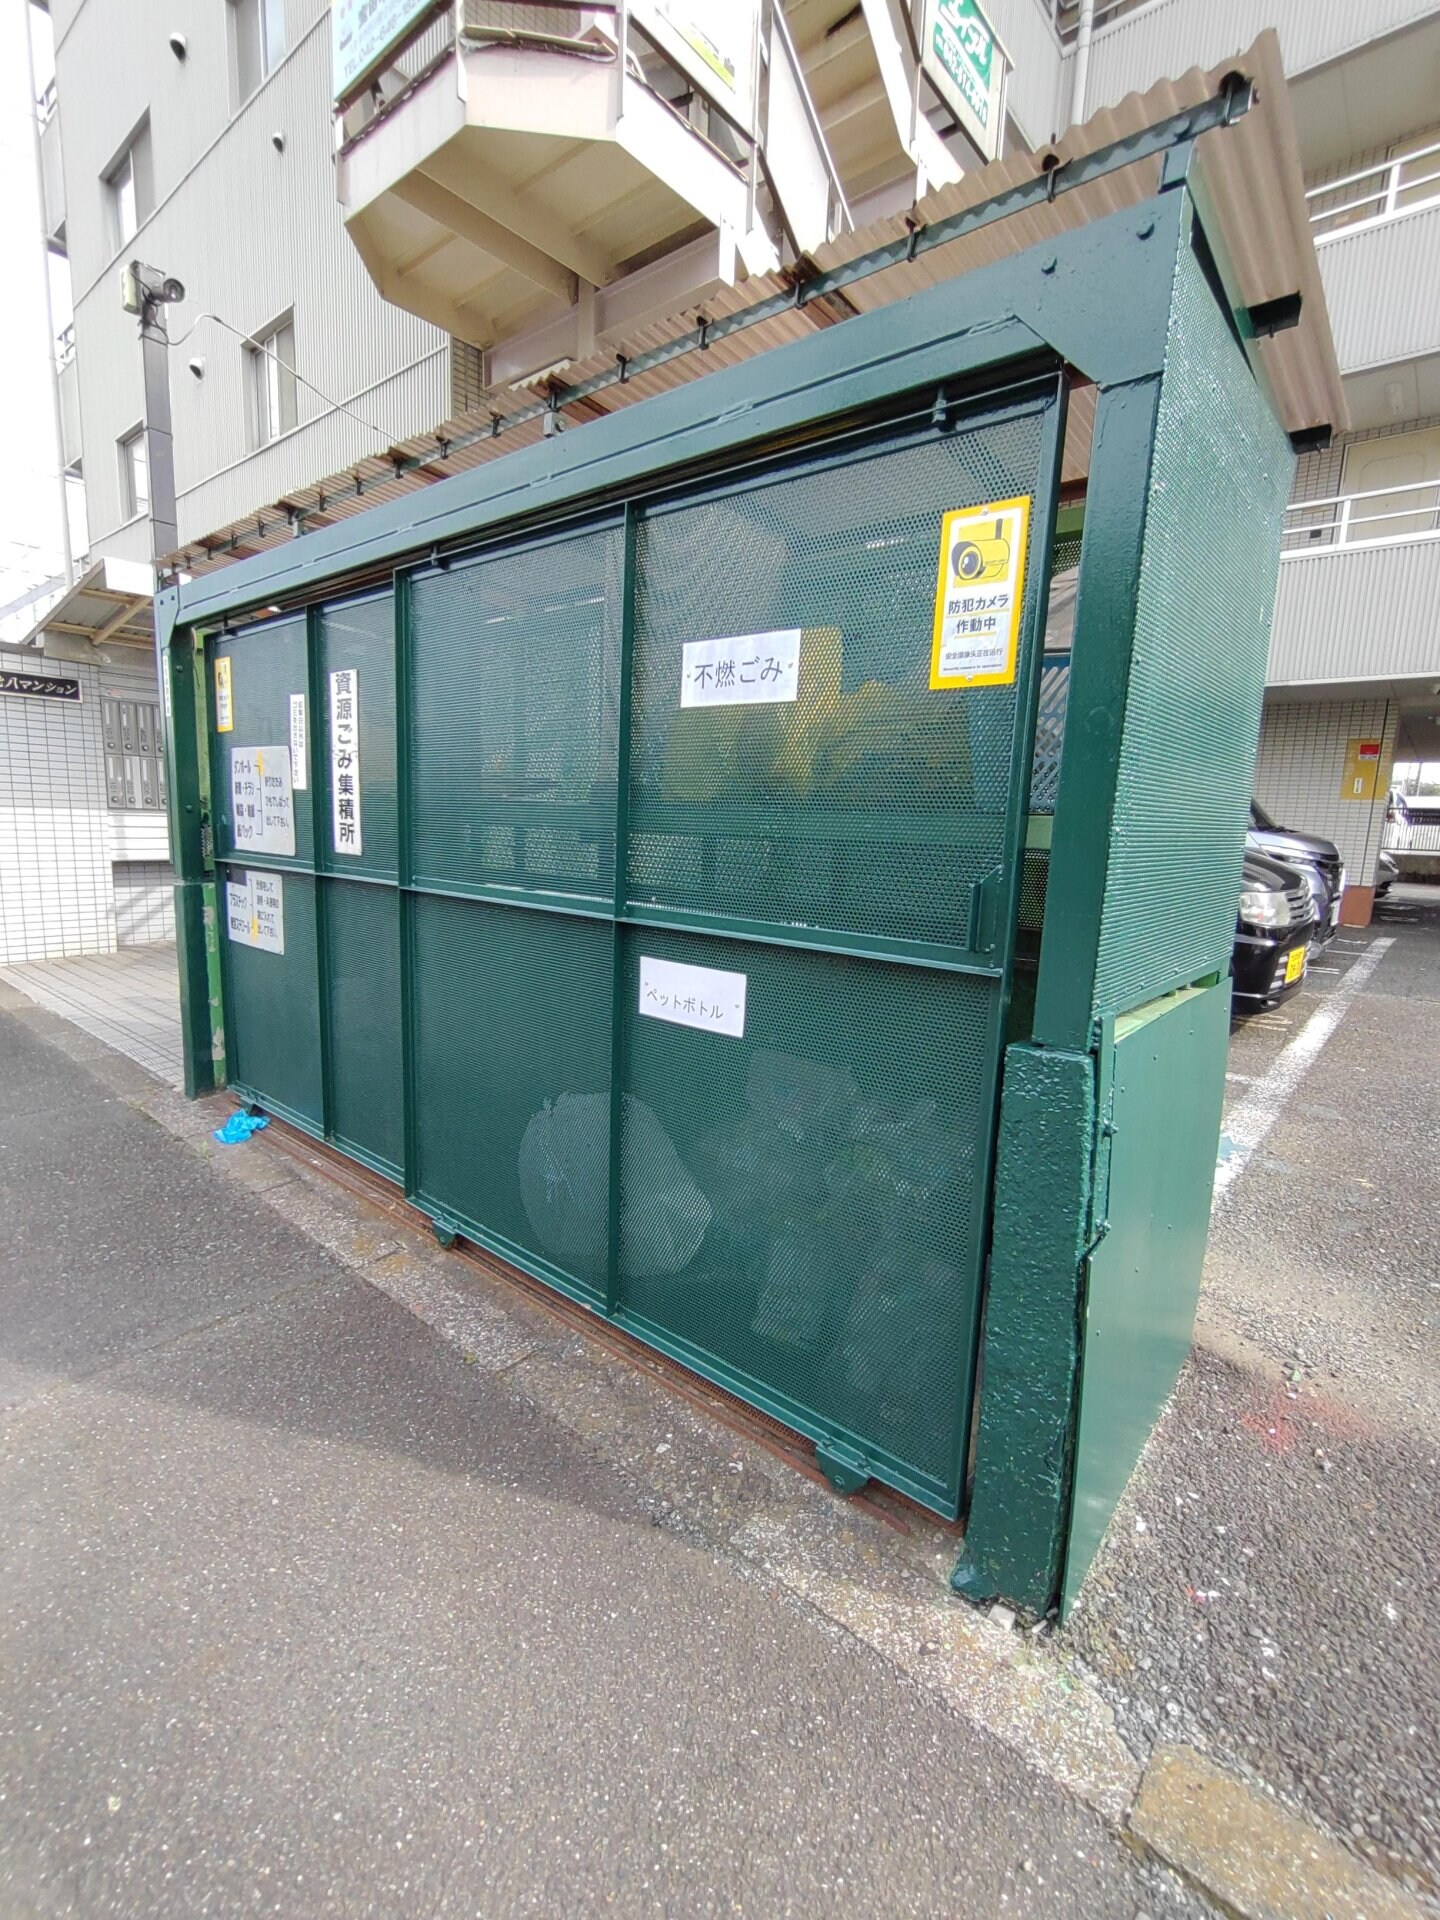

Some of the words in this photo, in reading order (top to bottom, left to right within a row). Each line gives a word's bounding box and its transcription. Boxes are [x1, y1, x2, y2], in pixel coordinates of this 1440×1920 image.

[948, 593, 1009, 615] 防犯カメラ
[956, 616, 996, 635] 作動中
[694, 655, 784, 690] 不燃ごみ
[0, 675, 78, 695] 八マンション
[234, 760, 251, 774] ダンボール
[335, 672, 355, 846] 資源ごみ集積所
[646, 987, 725, 1021] ペットボトル
